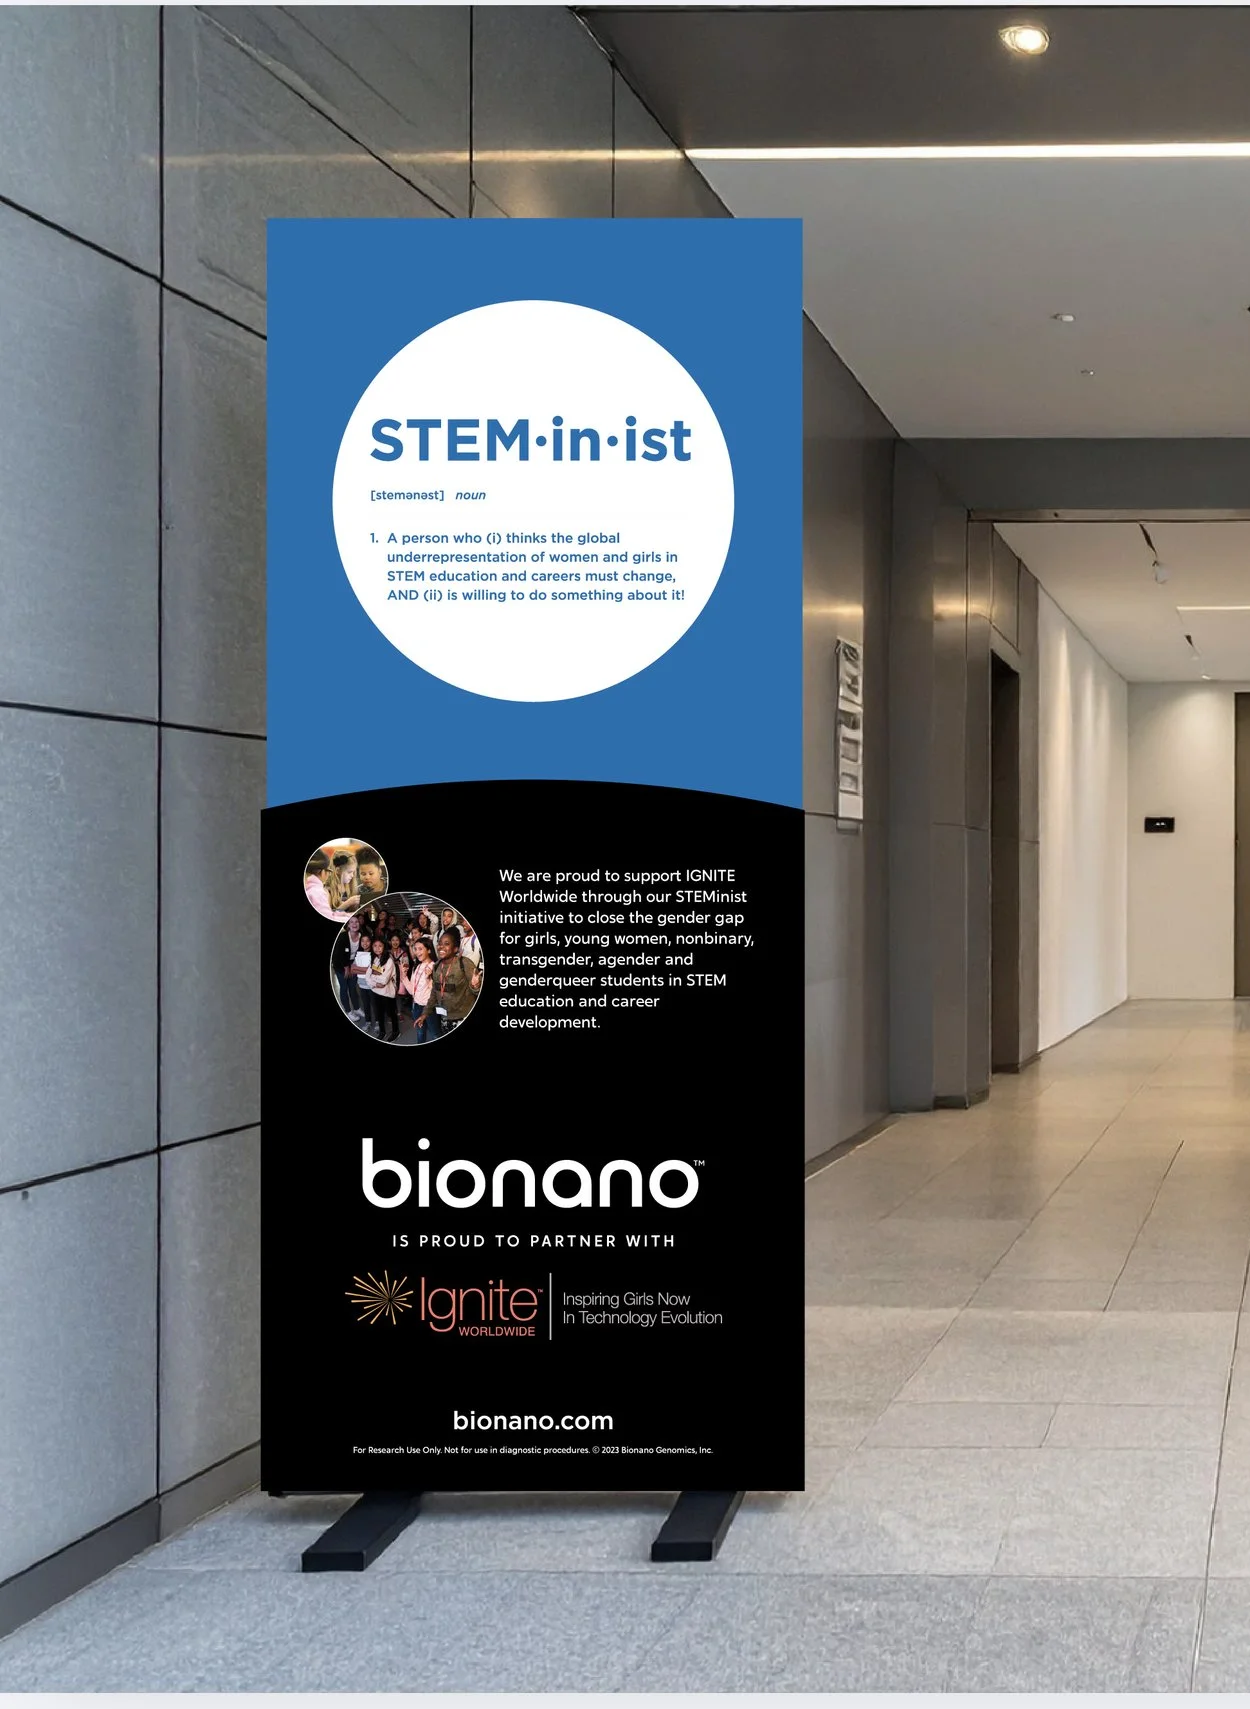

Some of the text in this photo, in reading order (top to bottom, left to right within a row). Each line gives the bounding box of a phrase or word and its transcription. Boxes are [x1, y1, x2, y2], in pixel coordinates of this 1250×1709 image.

[455, 491, 487, 501] noun
[369, 532, 620, 546] 1. A person who (i) thinks the global
[387, 551, 678, 565] underrepresentation of women and girls in
[387, 570, 676, 584] STEM education and careers must change,
[387, 589, 685, 603] AND (ii) is willing to do something about it!
[498, 868, 736, 885] We are proud to support IGNITE
[499, 889, 748, 906] Worldwide through our STEMinist
[499, 910, 745, 927] initiative to close the gender gap
[499, 931, 754, 948] for girls, young women, nonbinary,
[499, 952, 694, 969] transgender, agender and
[499, 972, 727, 990] genderqueer students in STEM
[499, 993, 661, 1008] education and career
[499, 1014, 601, 1032] development.
[362, 1138, 699, 1208] bionano
[392, 1234, 674, 1248] IS PROUD TO PARTNER WITH
[420, 1276, 538, 1332] Ignite
[563, 1291, 691, 1309] Inspiring Girls Now
[563, 1310, 723, 1328] In Technology Evolution
[458, 1326, 536, 1337] WORLDWIDE
[453, 1410, 614, 1431] bionano.com
[352, 1446, 367, 1454] For
[368, 1446, 405, 1454] Research
[406, 1446, 421, 1454] Use
[422, 1446, 443, 1456] Only.
[444, 1446, 459, 1454] Not
[460, 1445, 473, 1454] for
[490, 1445, 498, 1454] in
[499, 1445, 542, 1456] diagnostic
[543, 1446, 591, 1456] procedures.
[601, 1446, 620, 1454] 2023
[621, 1445, 655, 1454] Bionano
[655, 1446, 698, 1455] Genomics,
[699, 1446, 714, 1454] Inc.
